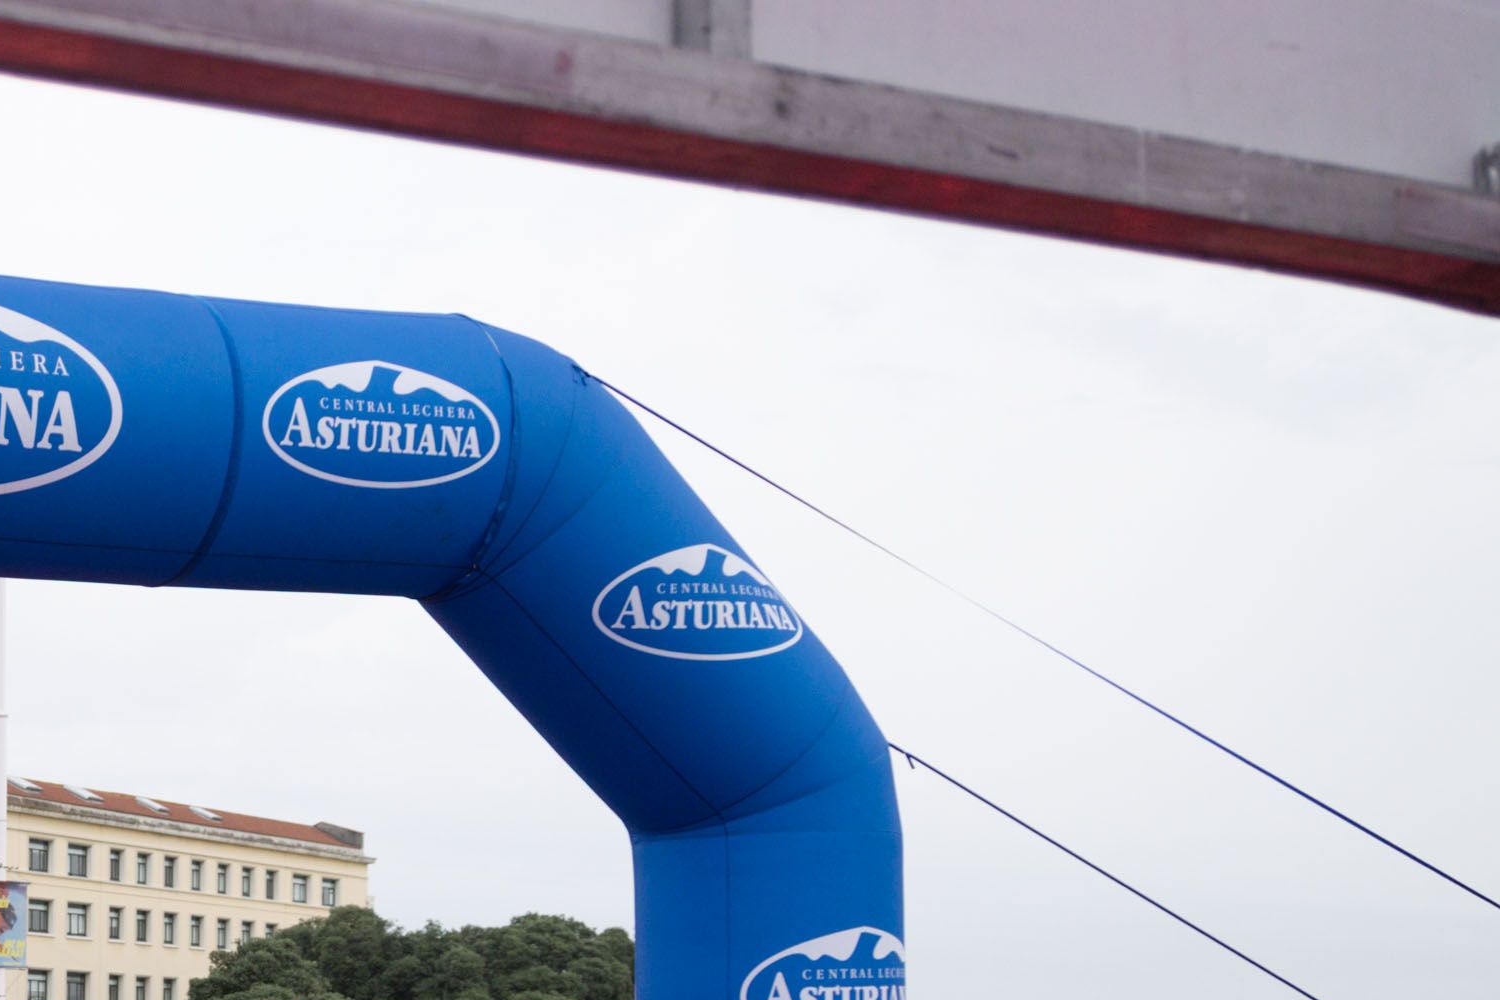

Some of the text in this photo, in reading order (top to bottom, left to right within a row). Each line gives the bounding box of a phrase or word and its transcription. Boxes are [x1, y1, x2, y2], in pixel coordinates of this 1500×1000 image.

[319, 396, 476, 420] CENTRAL LECHERA
[280, 397, 481, 459] ASTURIANA
[656, 582, 727, 594] CENTRAL
[610, 584, 797, 631] ASTURIANA
[802, 968, 874, 980] CENTRAL
